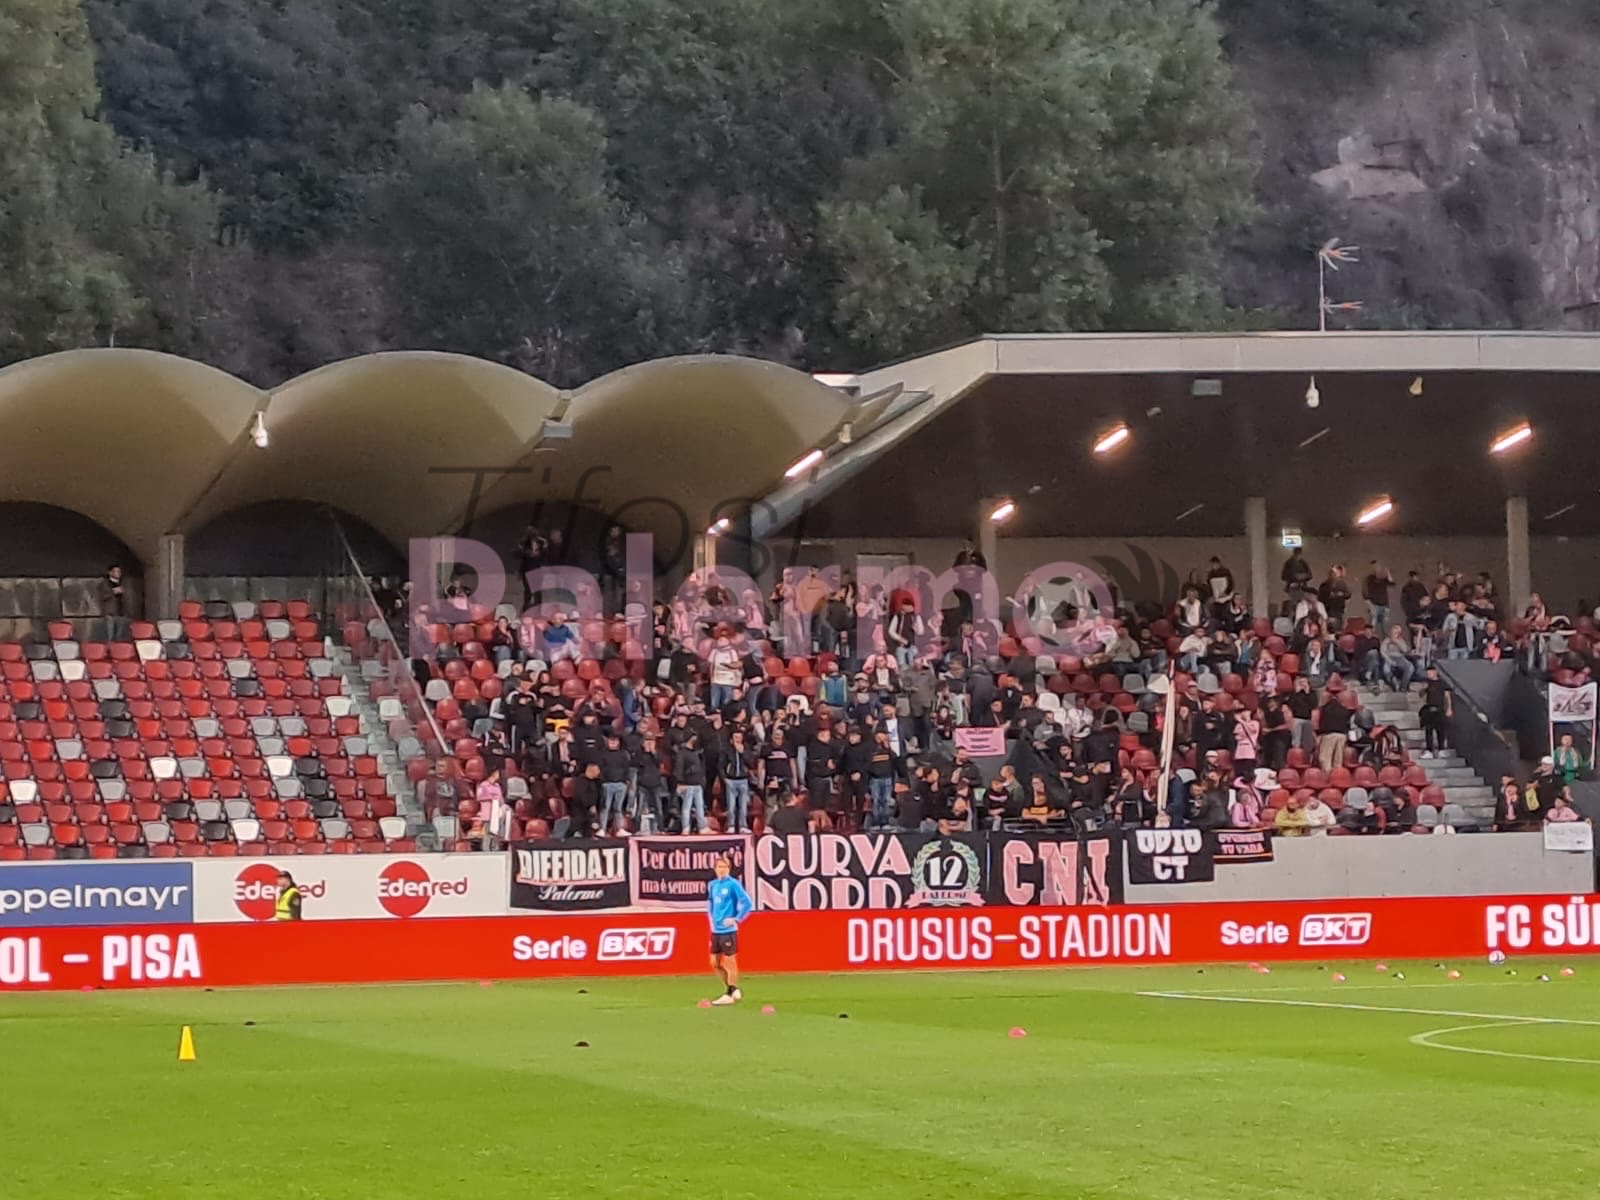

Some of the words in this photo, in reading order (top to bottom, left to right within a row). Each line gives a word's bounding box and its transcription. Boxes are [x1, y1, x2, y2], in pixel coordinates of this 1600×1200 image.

[756, 834, 911, 877] CURVA
[1135, 829, 1203, 854] ODIO
[517, 848, 625, 882] DIFFIDATI
[641, 847, 666, 870] Per
[668, 847, 690, 870] chi
[926, 855, 963, 886] 12
[1152, 855, 1189, 880] CT
[378, 876, 468, 898] Edenred
[538, 885, 604, 901] Palermo
[848, 913, 1171, 962] DRUSUS-STADION
[1220, 921, 1289, 945] Serie
[1302, 917, 1367, 943] BKT
[1486, 904, 1531, 948] FC
[0, 937, 50, 983] OL
[103, 933, 201, 980] PISA
[513, 935, 587, 960] Serie
[602, 931, 670, 955] BKT
